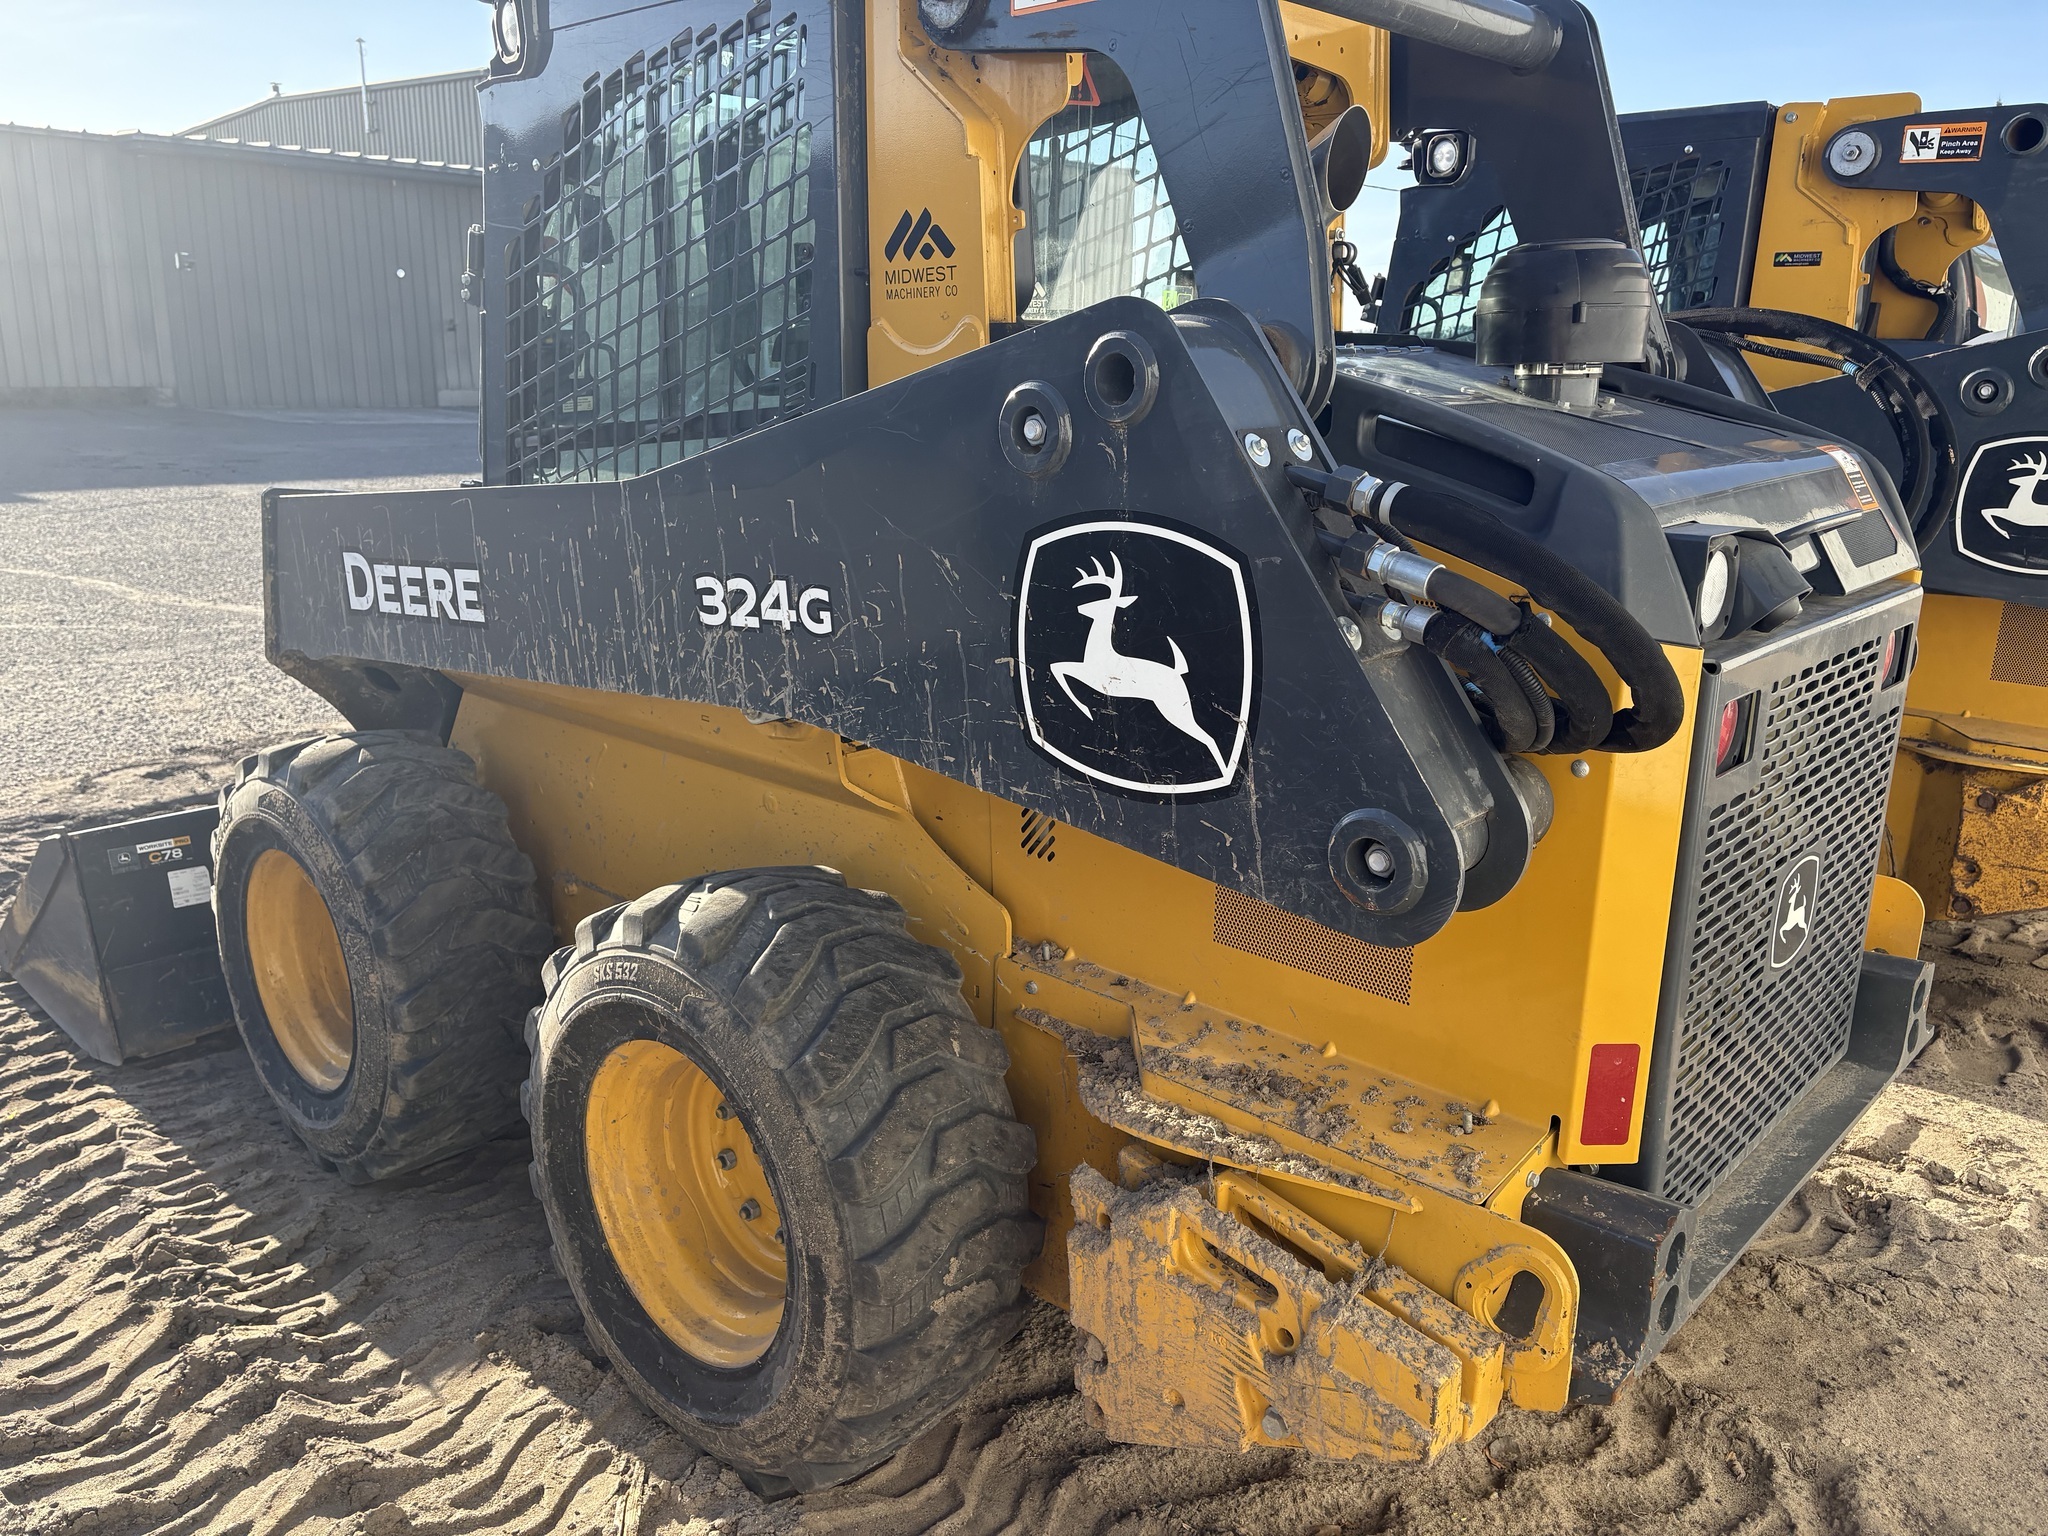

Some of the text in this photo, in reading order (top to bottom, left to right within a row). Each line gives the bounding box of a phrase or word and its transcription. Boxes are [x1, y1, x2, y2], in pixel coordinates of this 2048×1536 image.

[1951, 126, 1983, 134] WARNING
[885, 265, 957, 285] MIDWEST
[886, 284, 958, 300] MACHINERY CO
[342, 551, 486, 623] DEERE
[695, 576, 833, 635] 324G
[138, 841, 173, 851] WORKSITE
[148, 847, 183, 863] C78
[593, 961, 639, 982] SKS 532
